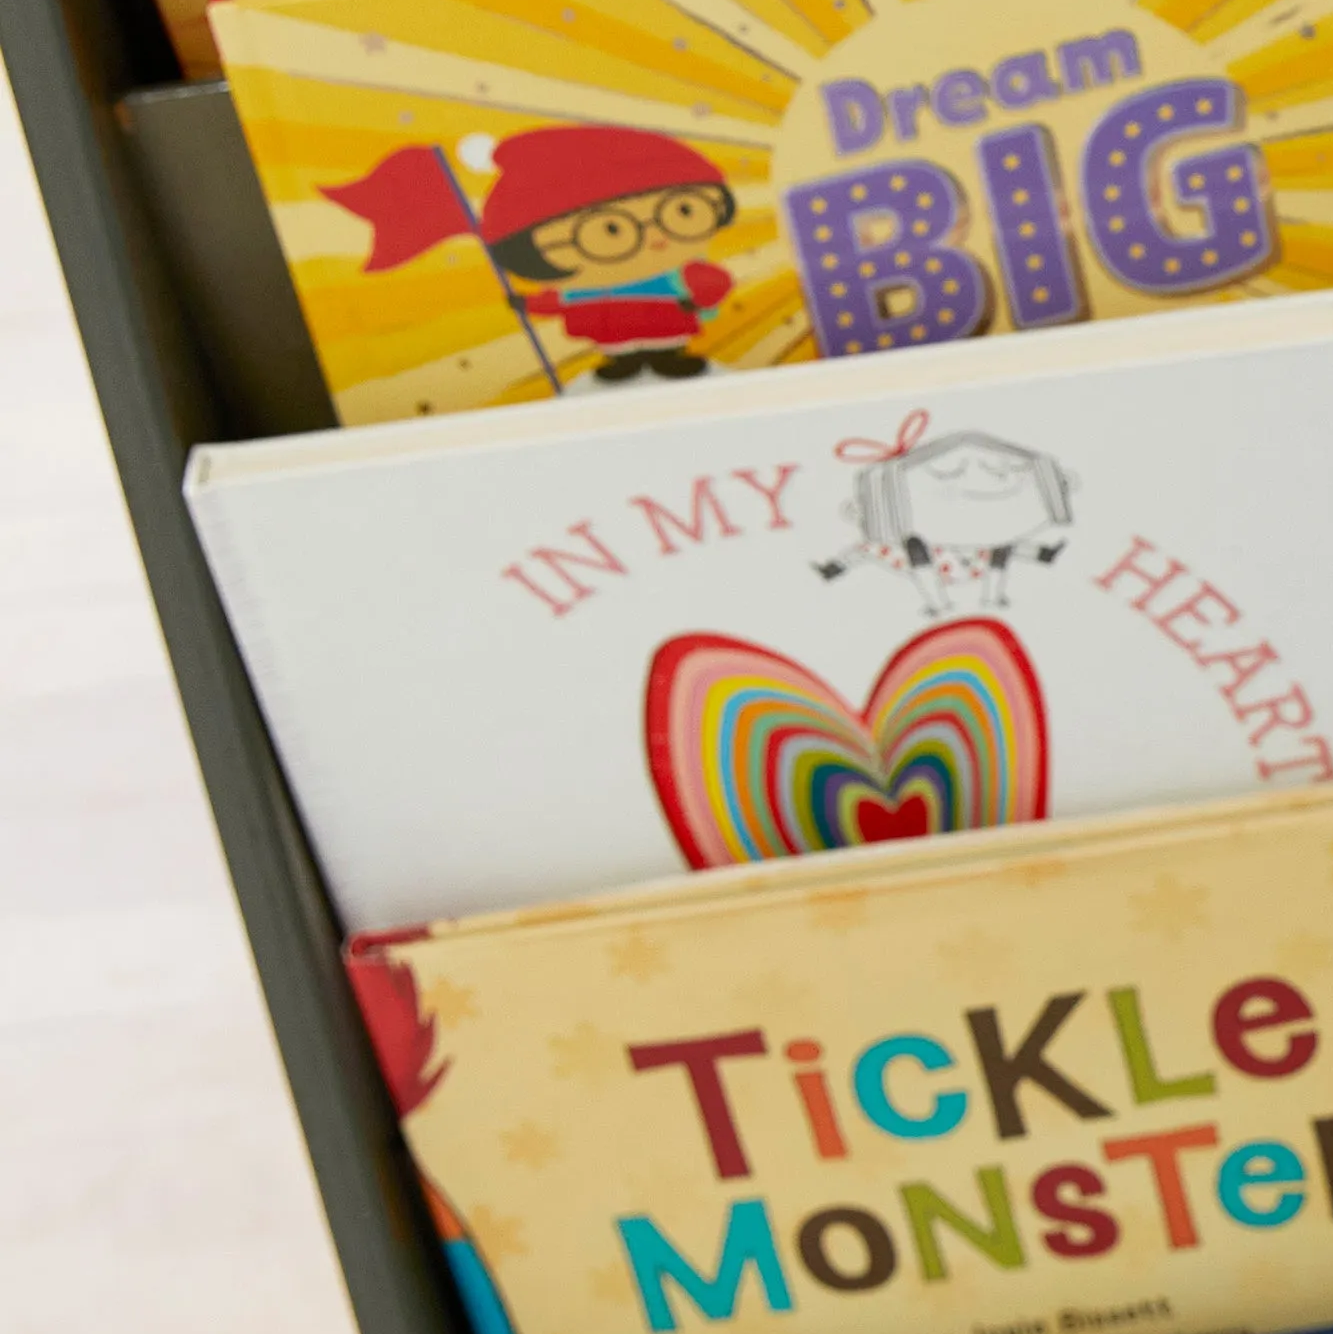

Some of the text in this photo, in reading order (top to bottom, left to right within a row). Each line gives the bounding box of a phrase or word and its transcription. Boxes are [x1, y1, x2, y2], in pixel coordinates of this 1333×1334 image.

[818, 27, 1144, 157] Dream
[782, 75, 1284, 361] BIG
[500, 517, 630, 620] IN
[629, 462, 800, 558] MY
